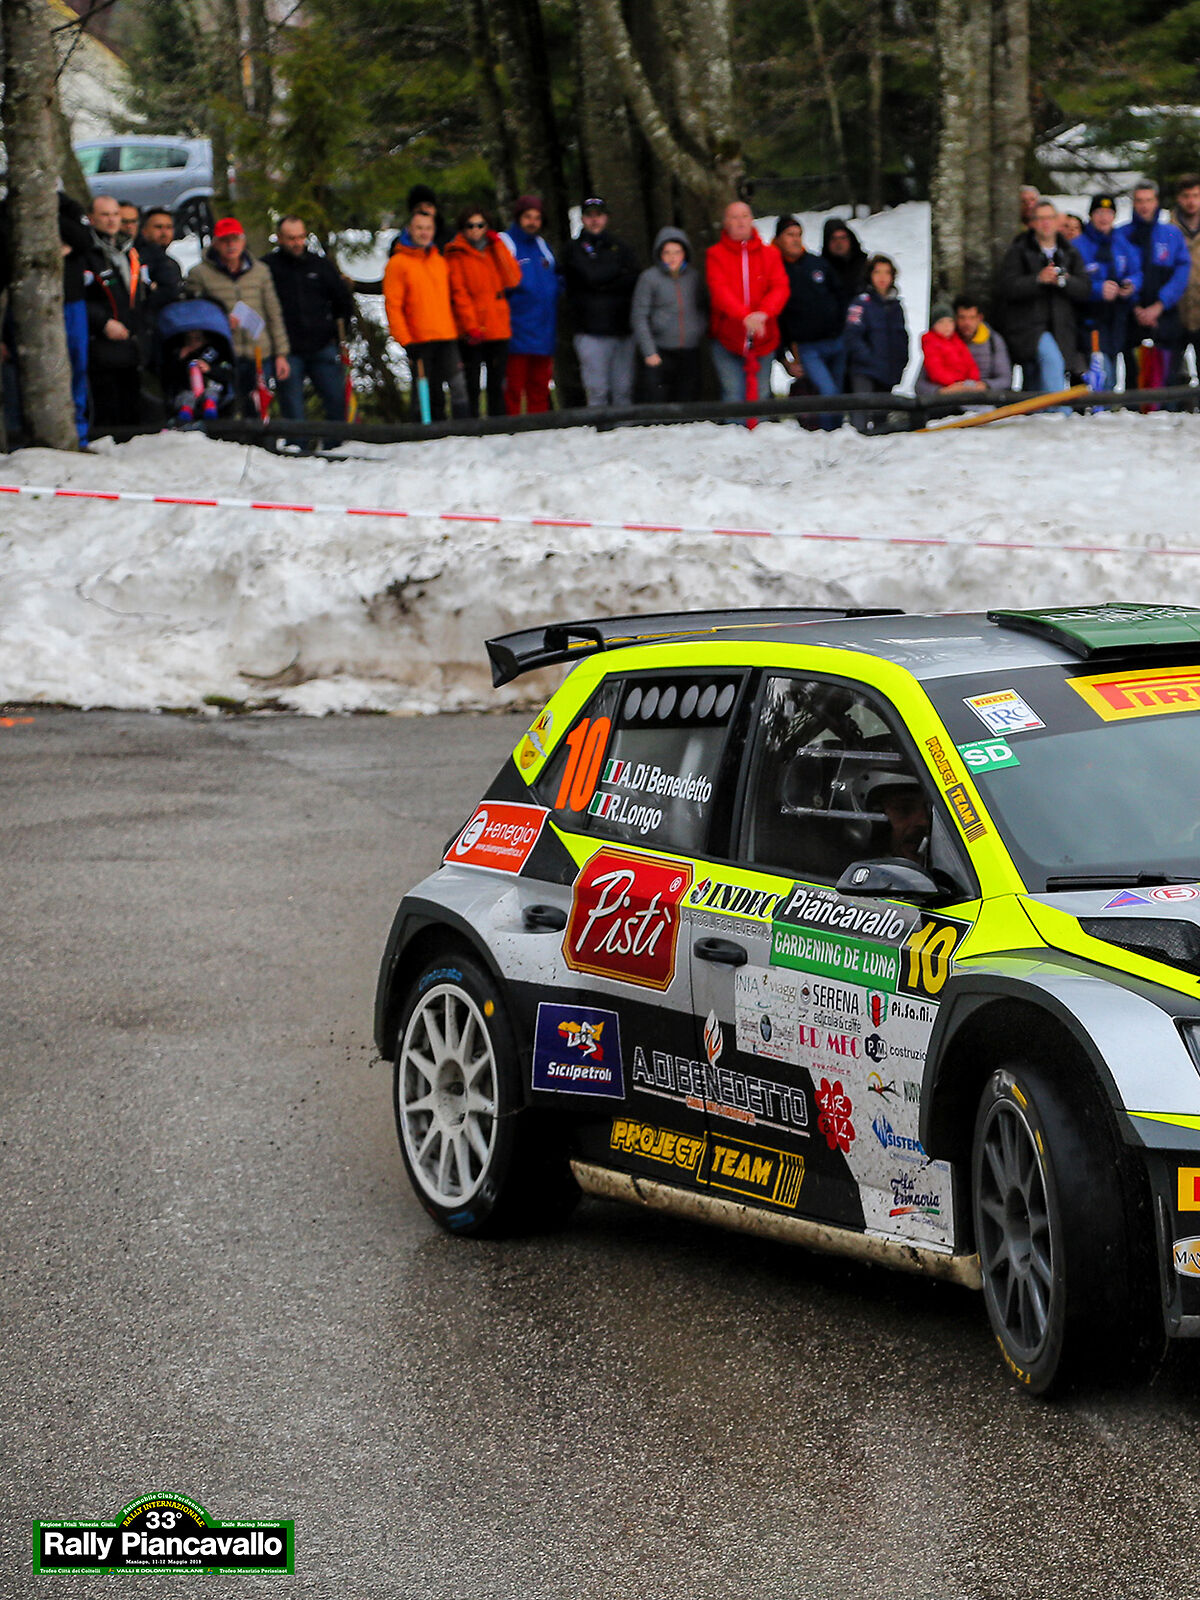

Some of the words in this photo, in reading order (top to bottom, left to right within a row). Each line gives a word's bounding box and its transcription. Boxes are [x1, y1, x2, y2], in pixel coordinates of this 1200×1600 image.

[984, 706, 1030, 726] IRC
[554, 716, 612, 812] 10
[963, 744, 1013, 766] SD
[617, 761, 649, 791] A.Di
[646, 766, 713, 803] Benedetto
[925, 736, 958, 786] PROJECT
[950, 788, 976, 825] TEAM
[604, 795, 663, 835] R.Longo
[783, 890, 905, 939] Piancavallo
[774, 931, 842, 968] GARDENING
[844, 949, 859, 970] DE
[863, 953, 897, 980] LUNA
[904, 922, 958, 994] 10
[813, 984, 860, 1016] SERENA
[826, 1032, 862, 1060] MEC
[547, 1061, 612, 1081] Sicilpetroli
[675, 1057, 809, 1127] BENEDETTO
[609, 1117, 704, 1170] PROJECT
[710, 1144, 774, 1186] TEAM
